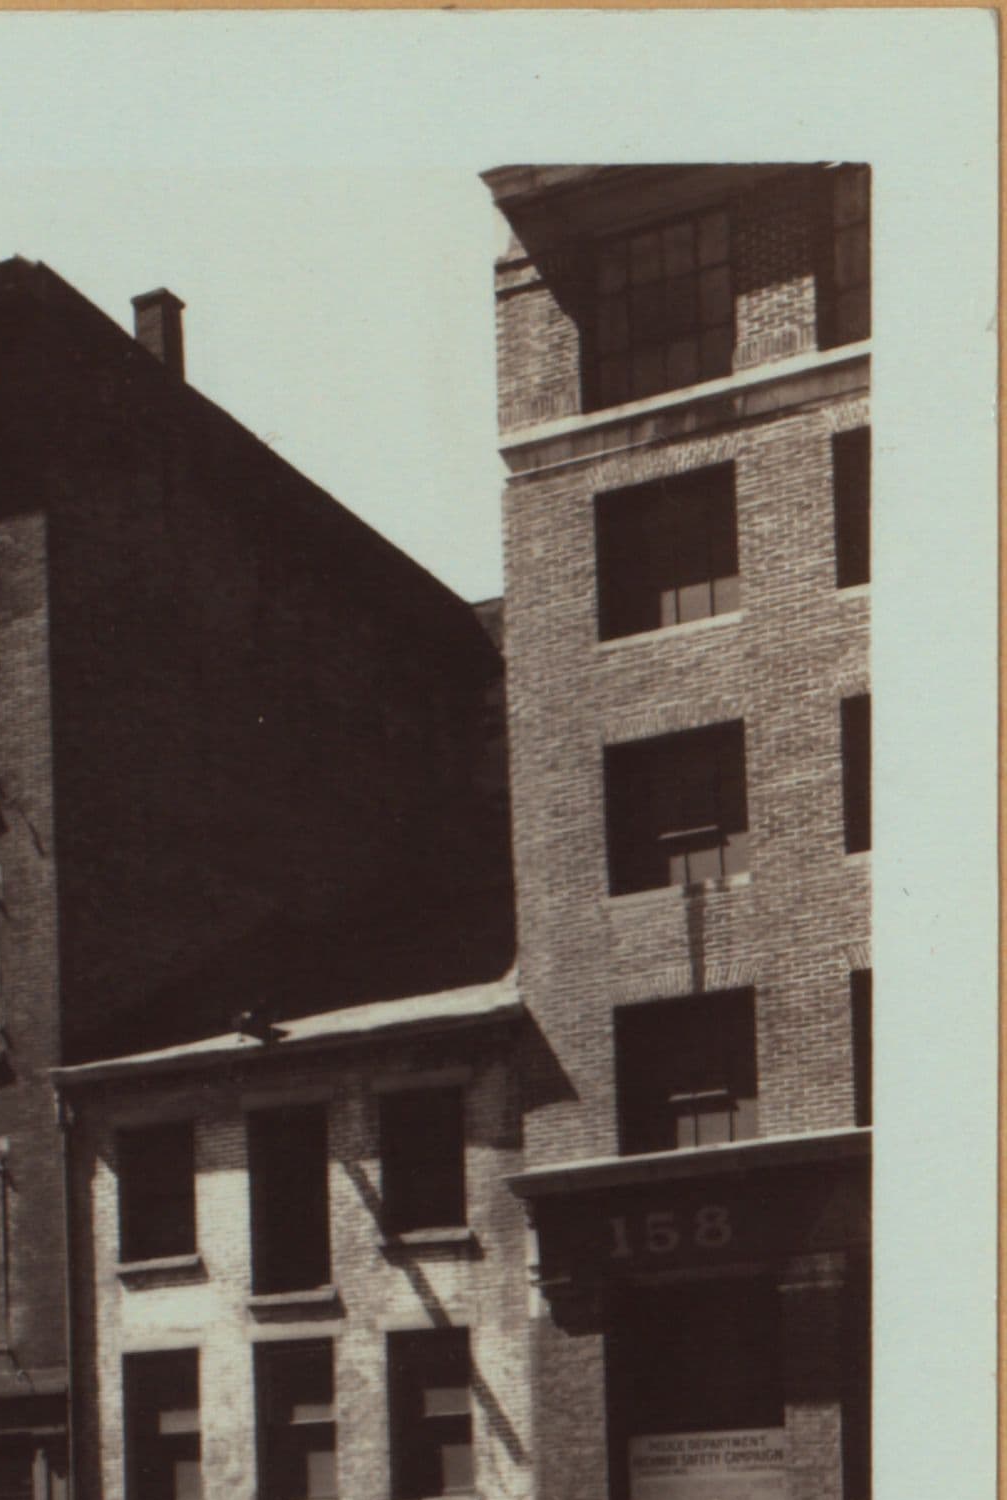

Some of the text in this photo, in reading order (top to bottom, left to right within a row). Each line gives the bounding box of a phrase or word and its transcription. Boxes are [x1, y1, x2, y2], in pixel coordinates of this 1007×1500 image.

[609, 1205, 732, 1259] 158
[687, 1436, 766, 1449] DEPARTMENT
[724, 1447, 784, 1463] CAMPAIGN
